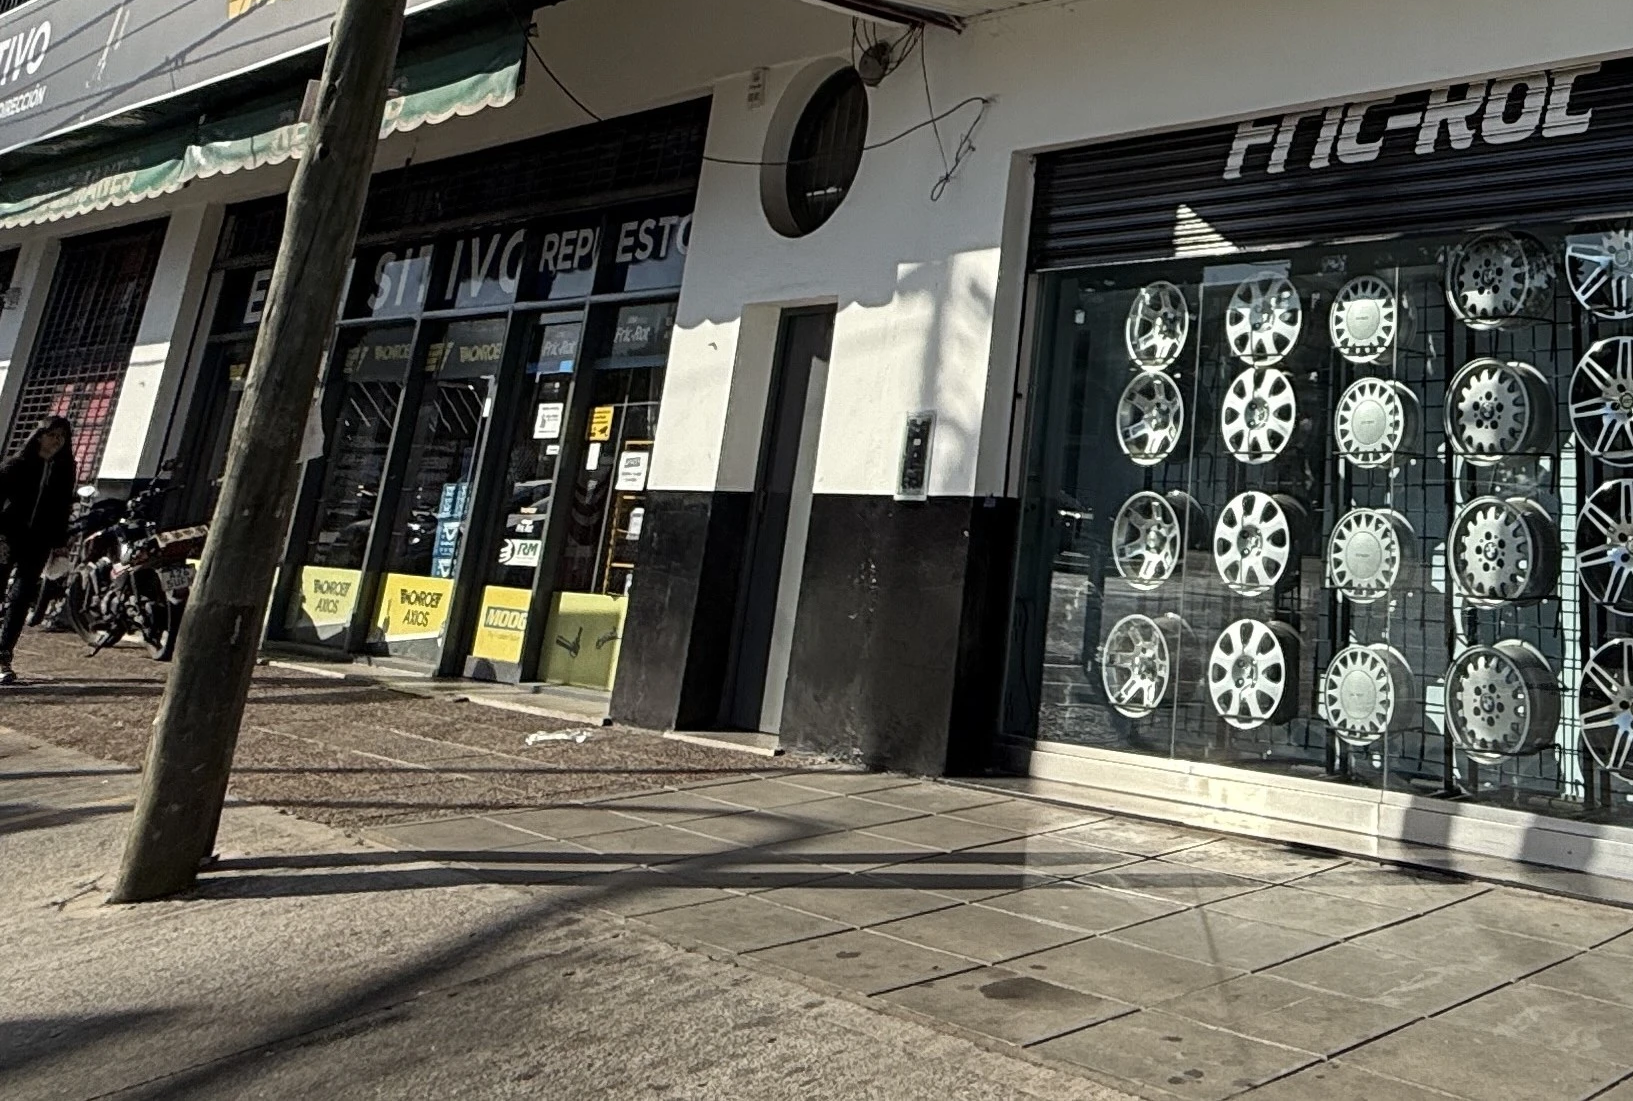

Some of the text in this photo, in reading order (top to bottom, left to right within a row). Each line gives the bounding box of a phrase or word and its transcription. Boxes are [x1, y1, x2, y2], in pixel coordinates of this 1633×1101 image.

[314, 579, 351, 597] MONROE
[400, 588, 443, 608] MONROE
[402, 609, 430, 627] AXIOS
